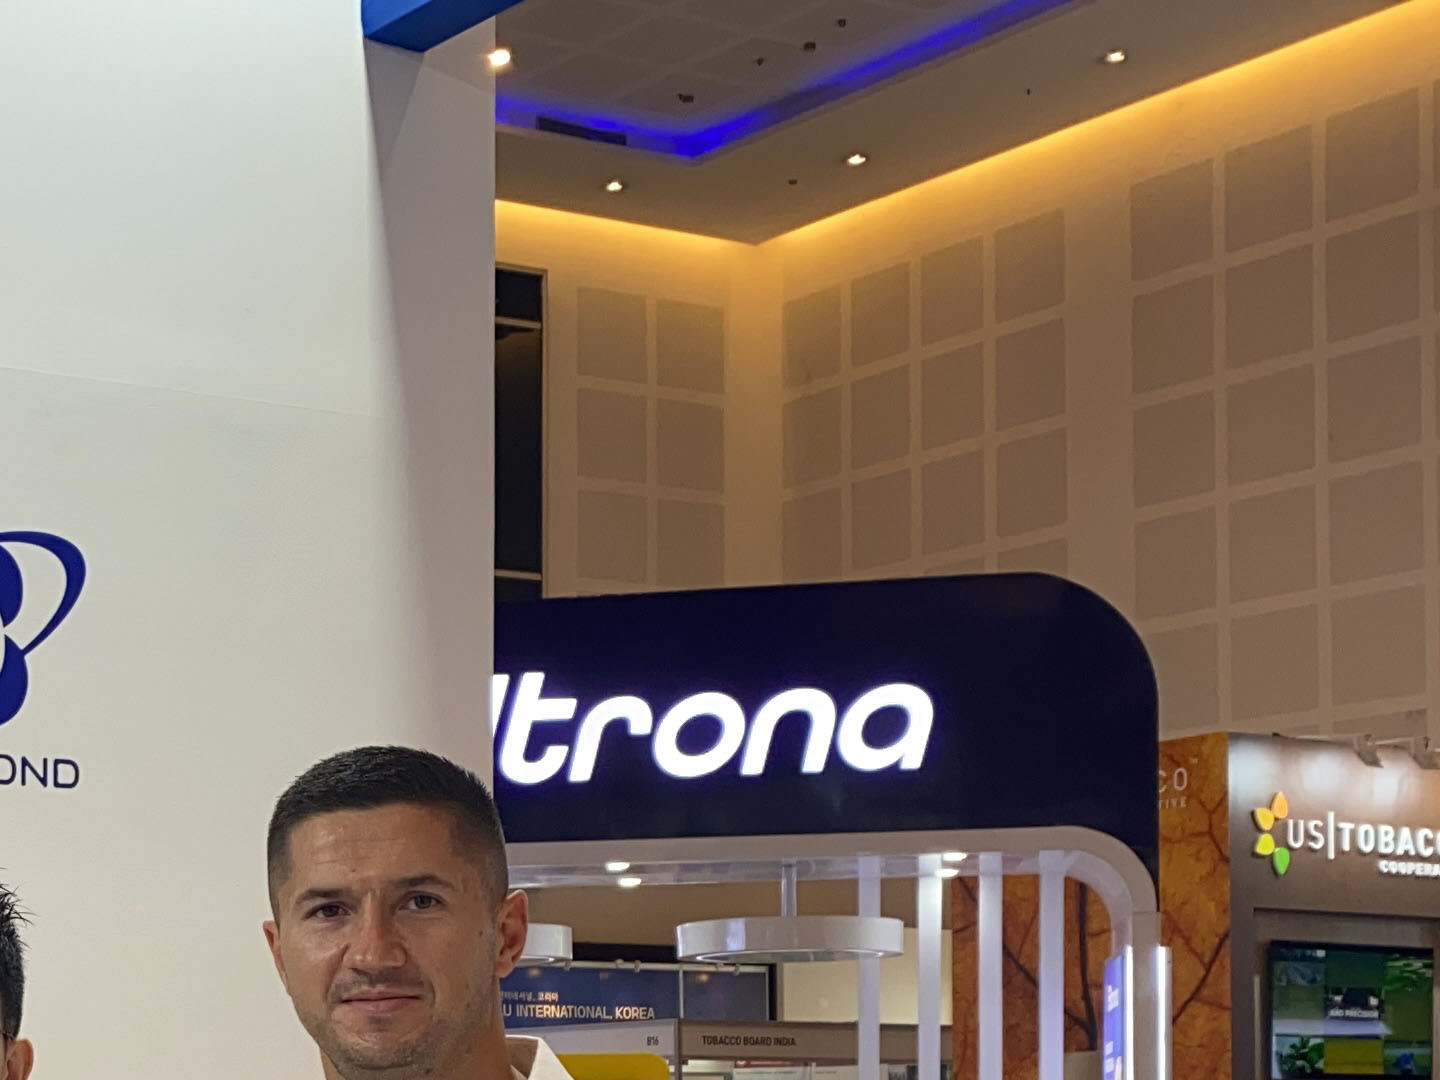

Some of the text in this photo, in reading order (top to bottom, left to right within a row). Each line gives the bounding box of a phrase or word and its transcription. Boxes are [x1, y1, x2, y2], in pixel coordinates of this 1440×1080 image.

[1337, 821, 1440, 858] TOBAC
[615, 1006, 655, 1021] KOREA
[702, 1035, 797, 1047] TOBACCO BOARD INDIA
